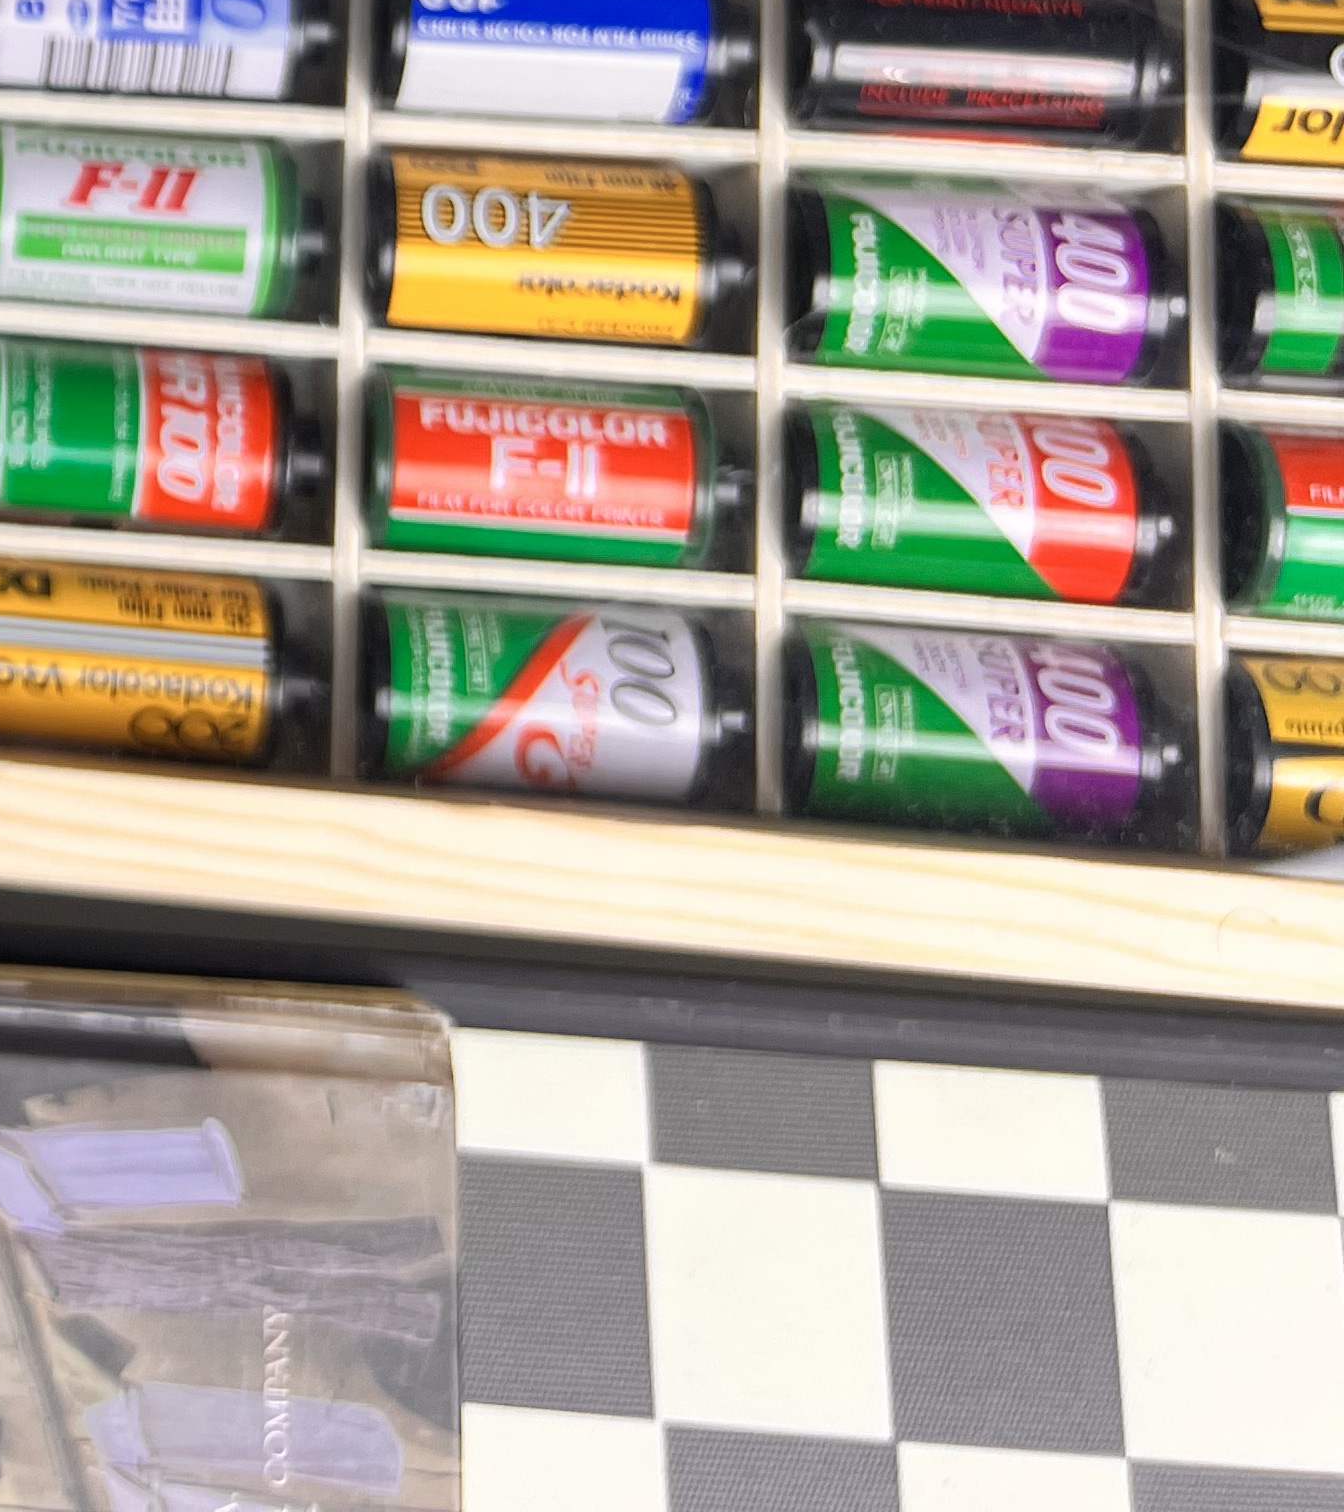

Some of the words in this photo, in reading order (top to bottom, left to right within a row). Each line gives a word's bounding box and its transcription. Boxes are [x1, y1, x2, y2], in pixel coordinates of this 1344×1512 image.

[419, 183, 572, 250] 400
[1052, 213, 1130, 332] 400
[156, 402, 209, 503] 100
[417, 398, 669, 448] FUJICOLOR
[598, 618, 679, 728] 100
[261, 1302, 292, 1486] COMPANY
